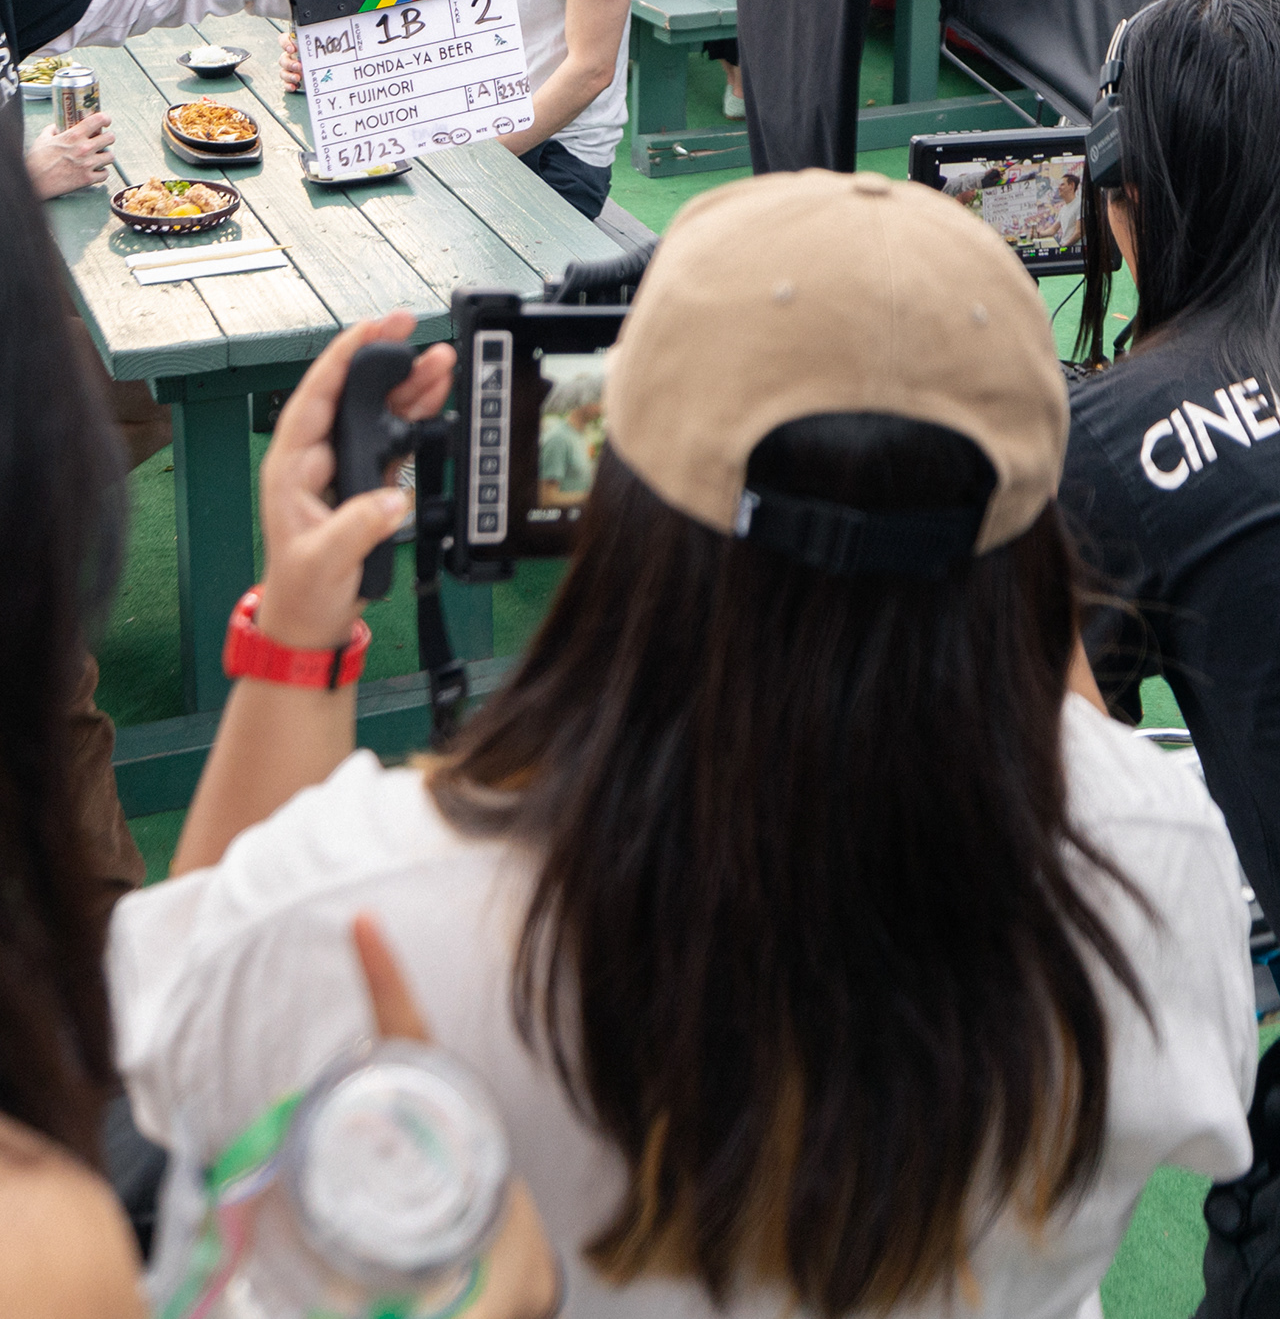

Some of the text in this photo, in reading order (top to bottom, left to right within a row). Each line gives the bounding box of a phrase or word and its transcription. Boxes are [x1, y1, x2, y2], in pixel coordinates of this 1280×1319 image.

[453, 0, 461, 24] TAKE
[375, 7, 426, 45] 1B
[304, 34, 313, 58] ROLL
[353, 40, 474, 81] HONDA-YA BEER
[327, 79, 414, 111] Y. FUJIMORI
[467, 87, 475, 104] CAM
[477, 82, 491, 98] A
[315, 98, 323, 116] DIR
[319, 122, 328, 141] CAM
[332, 105, 419, 137] C. MOUTON
[455, 132, 467, 140] DAY
[518, 116, 531, 124] MOS
[323, 147, 332, 172] DATE
